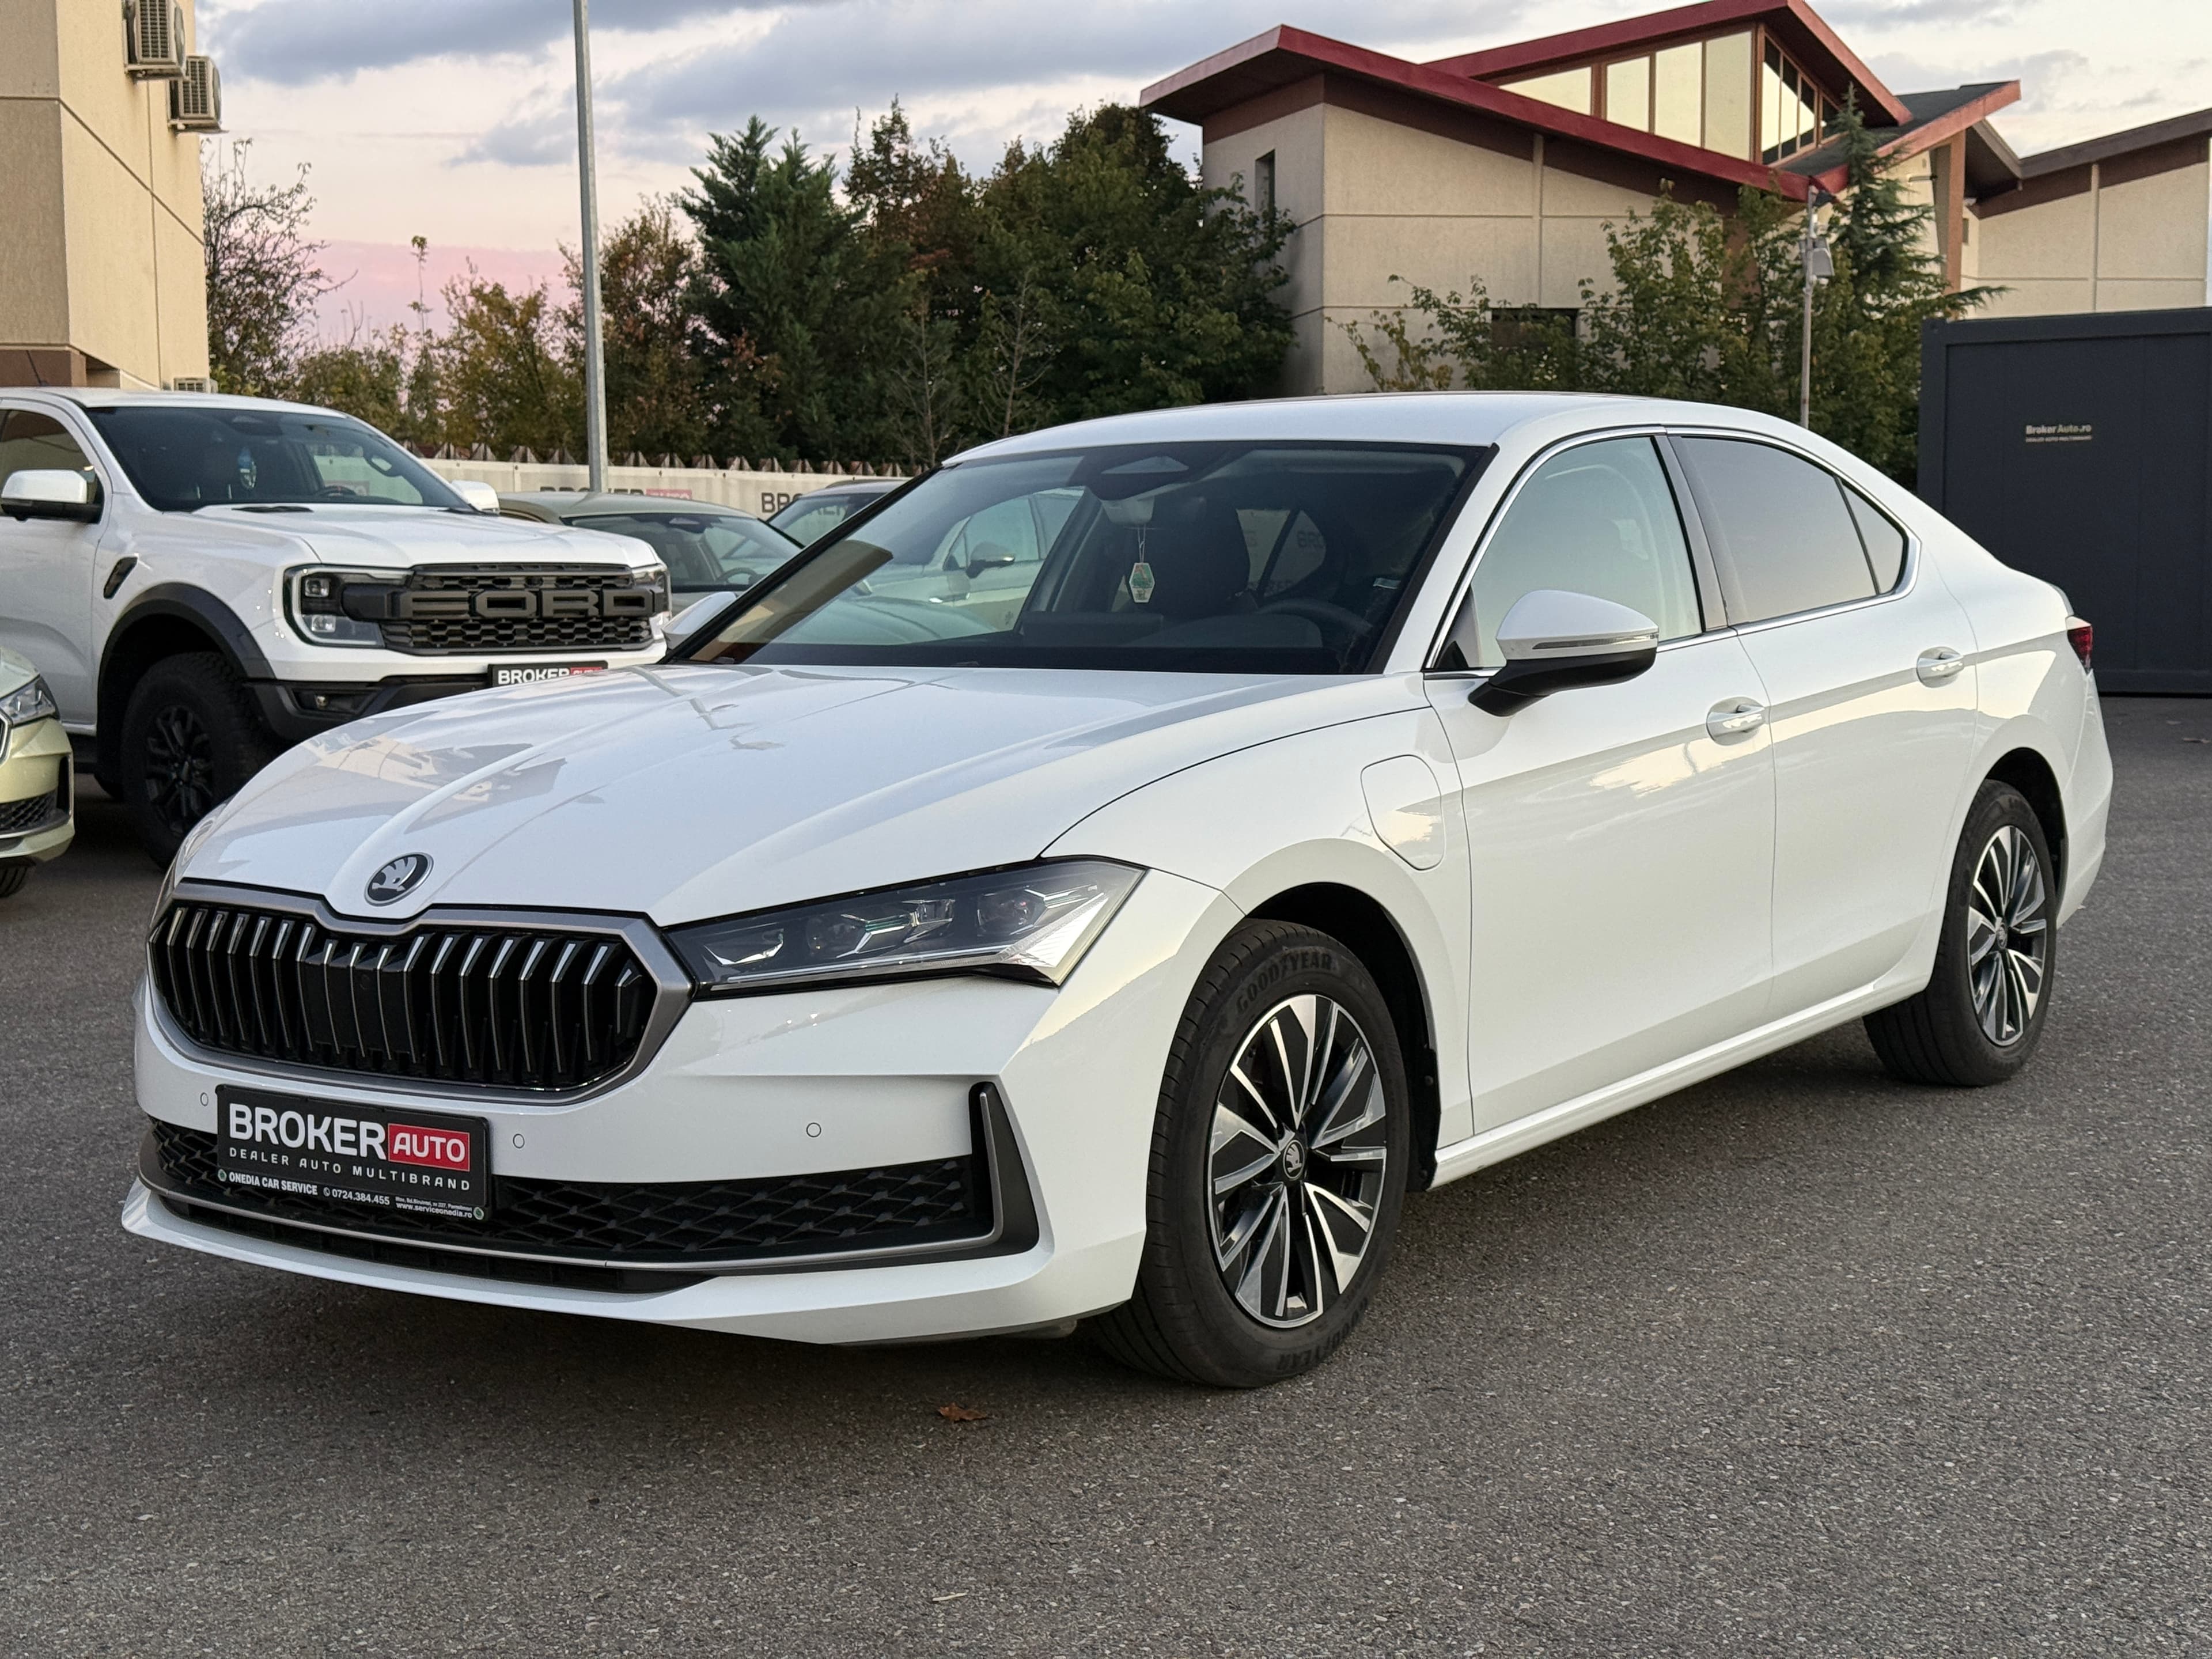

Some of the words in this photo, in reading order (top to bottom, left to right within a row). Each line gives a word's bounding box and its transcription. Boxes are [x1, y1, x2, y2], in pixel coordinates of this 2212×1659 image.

[400, 588, 654, 619] FORD
[498, 668, 570, 684] BROKER
[1236, 952, 1333, 1014] GOODYEAR
[229, 1103, 387, 1160] BROKER
[393, 1132, 465, 1162] AUTO
[229, 1147, 289, 1166] DEALER
[299, 1158, 342, 1173] AUTO
[353, 1165, 469, 1191] MULTIBRAND
[229, 1172, 260, 1187] ONEDIA
[262, 1177, 279, 1190] CAR
[281, 1180, 318, 1195] SERVICE
[332, 1191, 390, 1206] 0724.384.455
